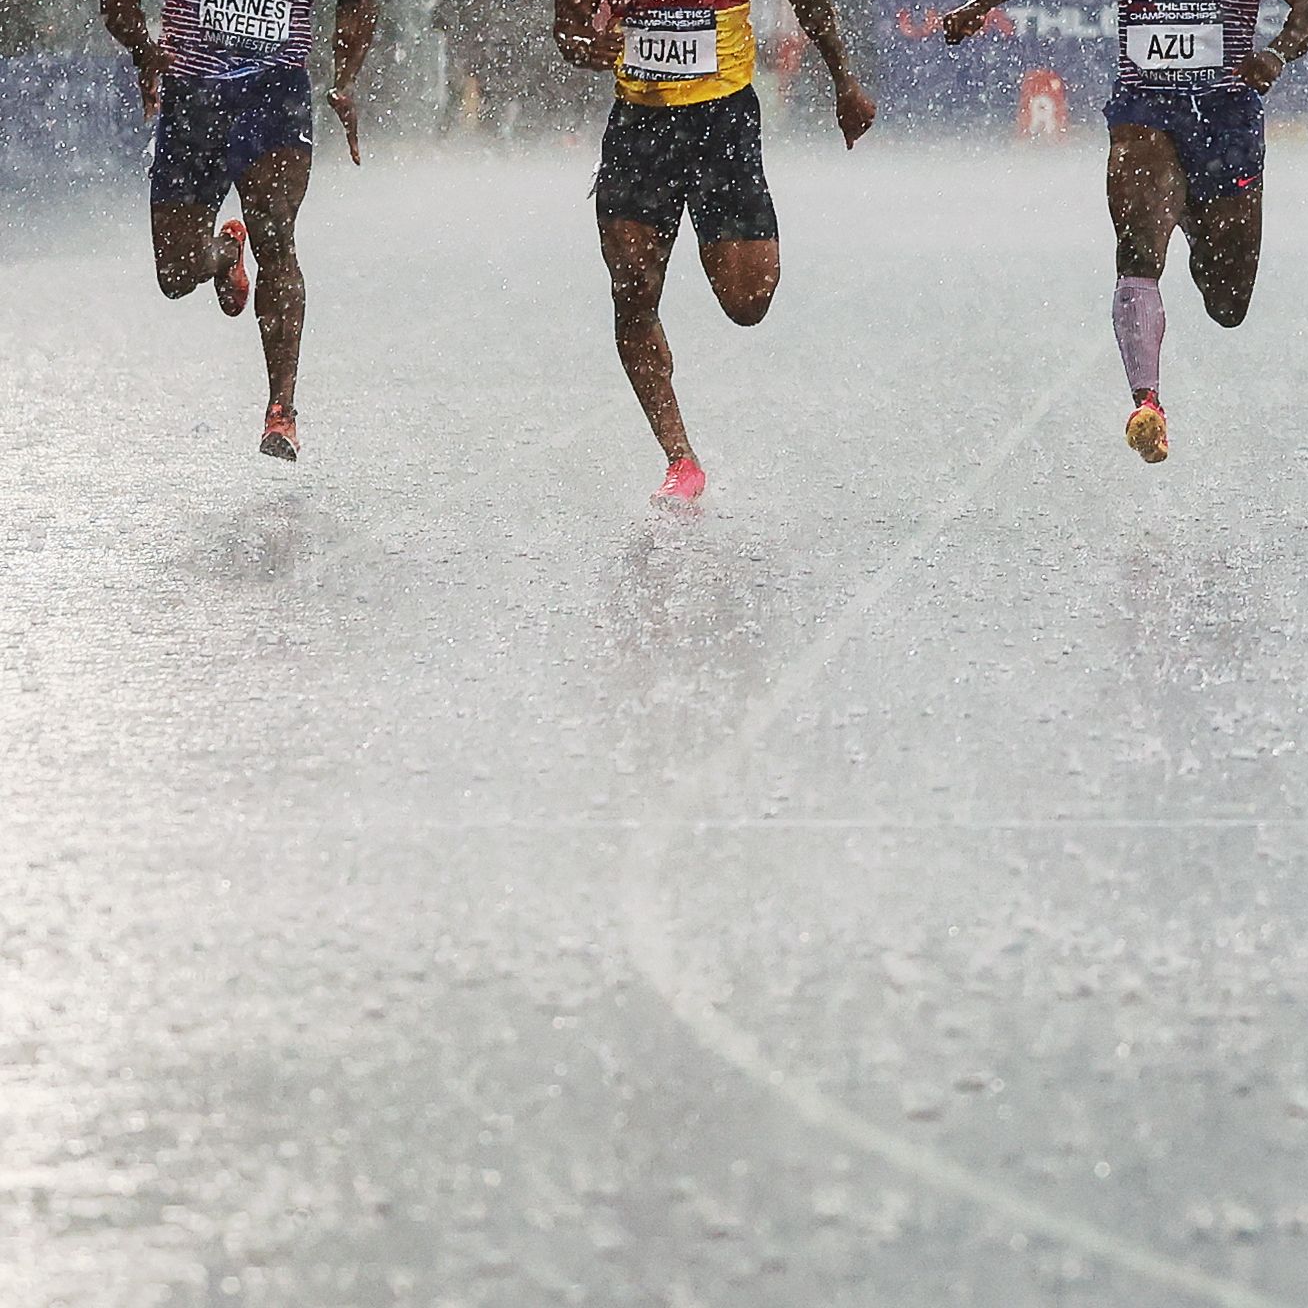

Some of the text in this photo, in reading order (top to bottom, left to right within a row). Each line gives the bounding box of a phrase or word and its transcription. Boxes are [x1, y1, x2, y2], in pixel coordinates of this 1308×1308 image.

[202, 9, 286, 41] ARYEETEY
[1129, 11, 1218, 21] CHAMPIONSHIPS
[638, 36, 698, 65] UJAH
[1146, 33, 1195, 60] AZU
